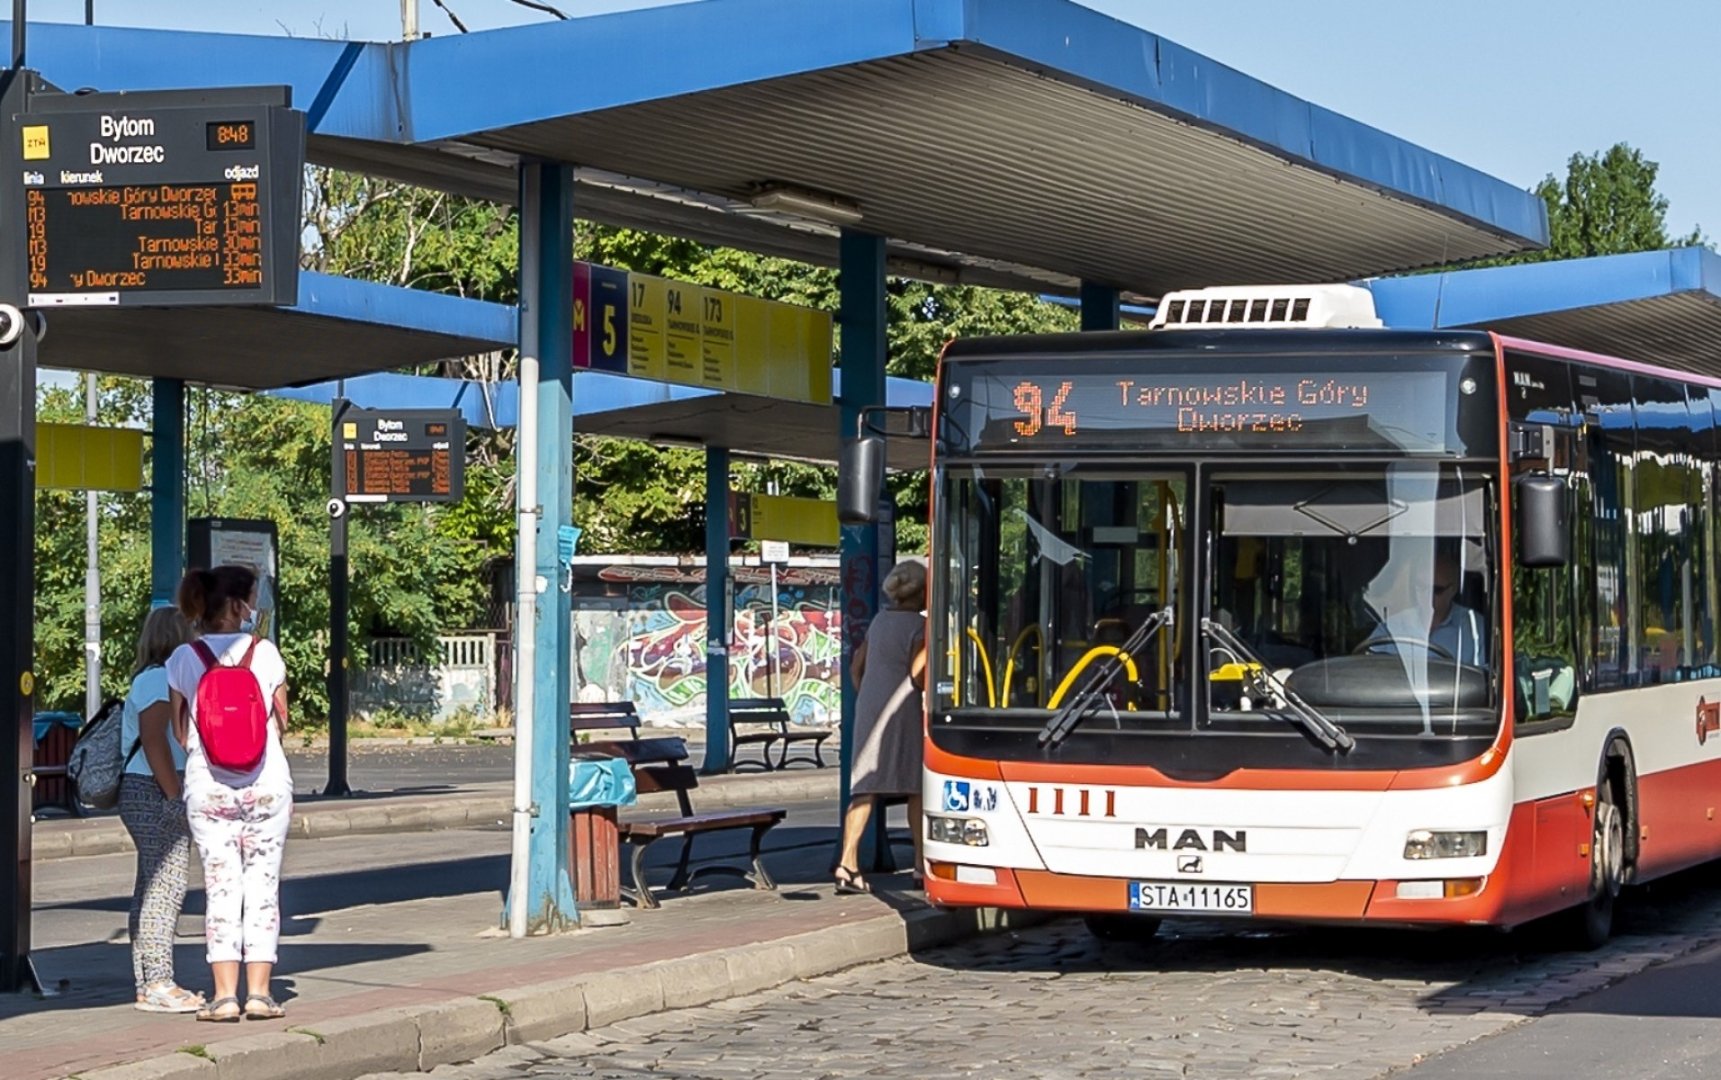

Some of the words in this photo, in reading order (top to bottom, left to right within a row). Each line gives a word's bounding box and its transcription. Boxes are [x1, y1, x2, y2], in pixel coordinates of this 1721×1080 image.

[101, 116, 154, 141] Bytom
[217, 125, 248, 144] 8:48
[90, 143, 164, 165] Dworzec
[23, 171, 44, 185] linia
[60, 170, 103, 184] kierunek
[225, 165, 259, 181] odjazd
[28, 191, 44, 206] 94
[123, 187, 157, 204] Góry
[120, 204, 200, 220] Tarnowskie
[29, 223, 45, 239] 19
[138, 236, 219, 252] Tarnowskie
[29, 256, 46, 272] 19
[133, 252, 211, 269] Tarnowskie
[86, 270, 146, 287] Dworzec
[632, 282, 645, 308] 17
[667, 289, 682, 315] 94
[704, 296, 722, 323] 173
[603, 304, 616, 356] 5
[1013, 381, 1077, 436] 94
[1116, 381, 1286, 407] Tarnowskie
[1298, 379, 1368, 408] Góry
[1178, 407, 1304, 433] Dworzec
[1135, 828, 1247, 852] MAN
[1141, 885, 1180, 907] STA
[1188, 886, 1250, 909] 11165
